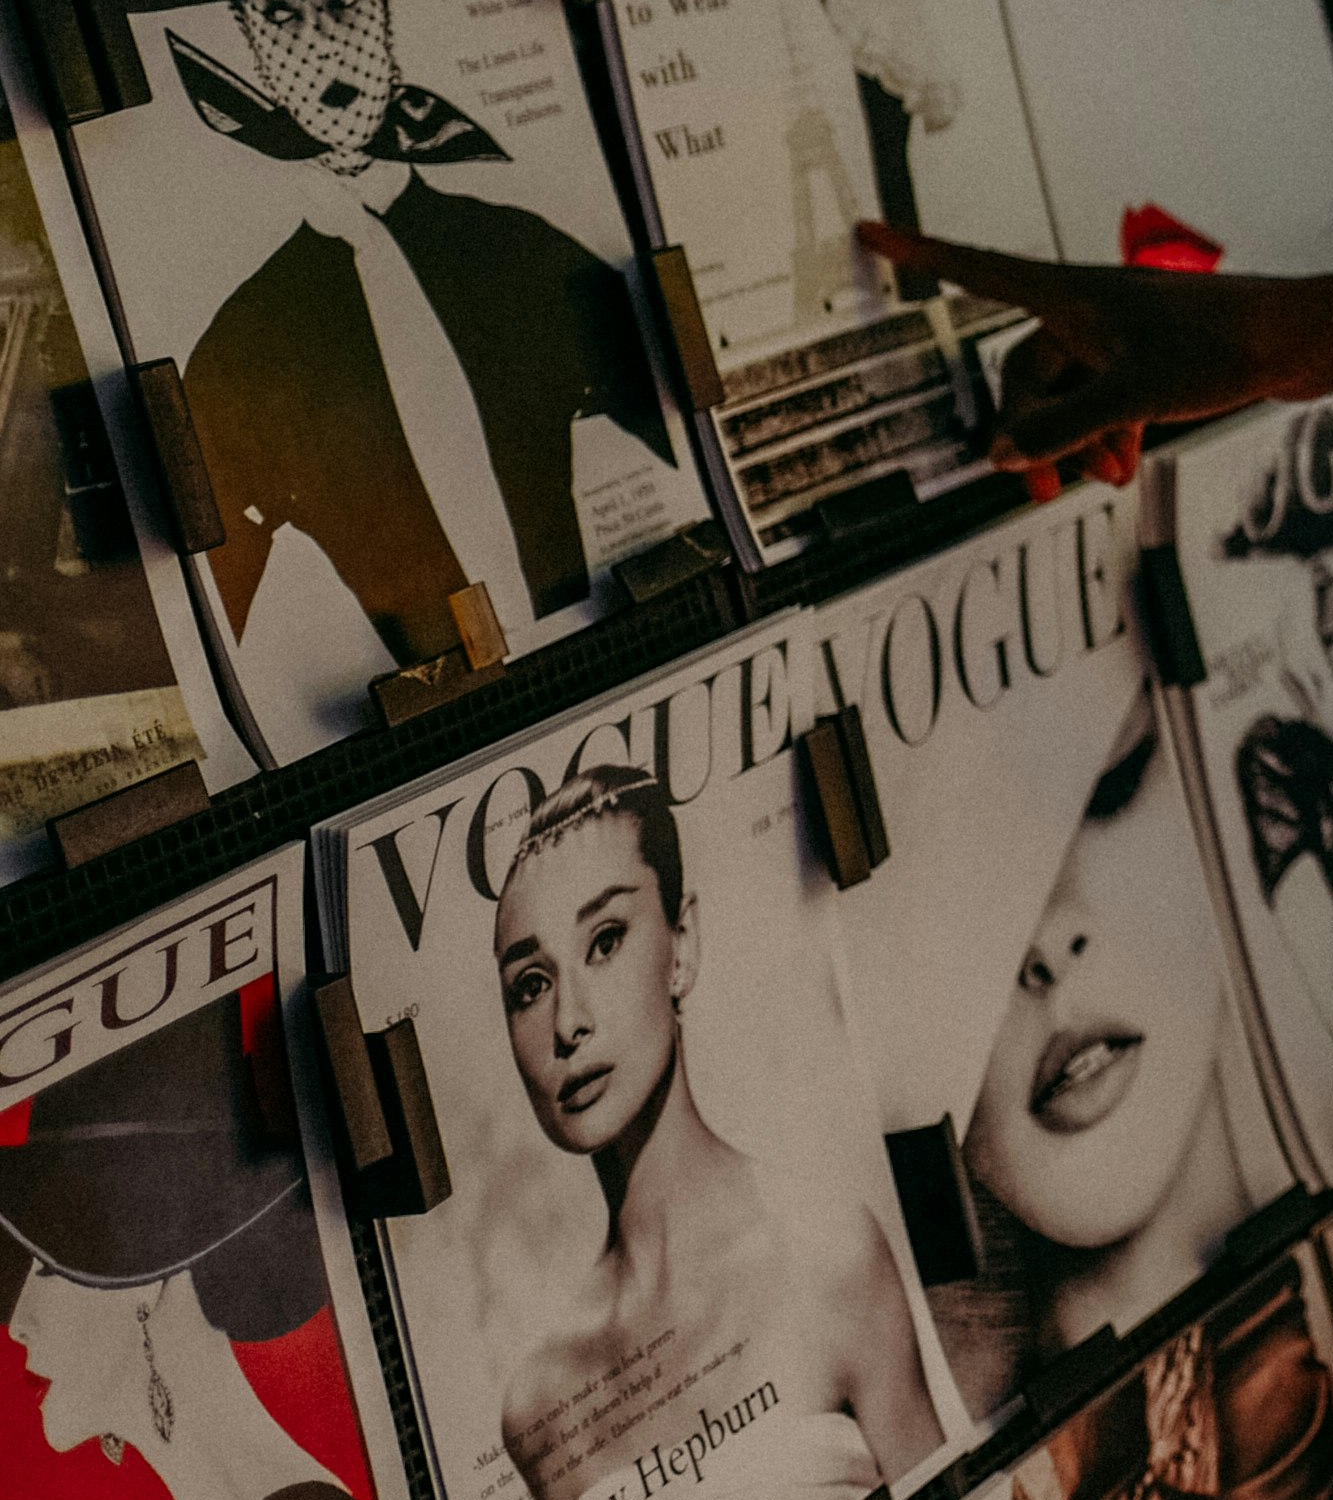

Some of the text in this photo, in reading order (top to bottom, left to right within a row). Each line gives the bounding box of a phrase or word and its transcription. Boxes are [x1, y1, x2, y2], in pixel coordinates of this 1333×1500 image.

[626, 3, 652, 27] to
[640, 50, 697, 88] with
[655, 123, 724, 160] What
[818, 503, 1125, 748] VOGUE
[131, 718, 168, 751] ÉTÉ
[633, 1381, 781, 1500] Hepburn
